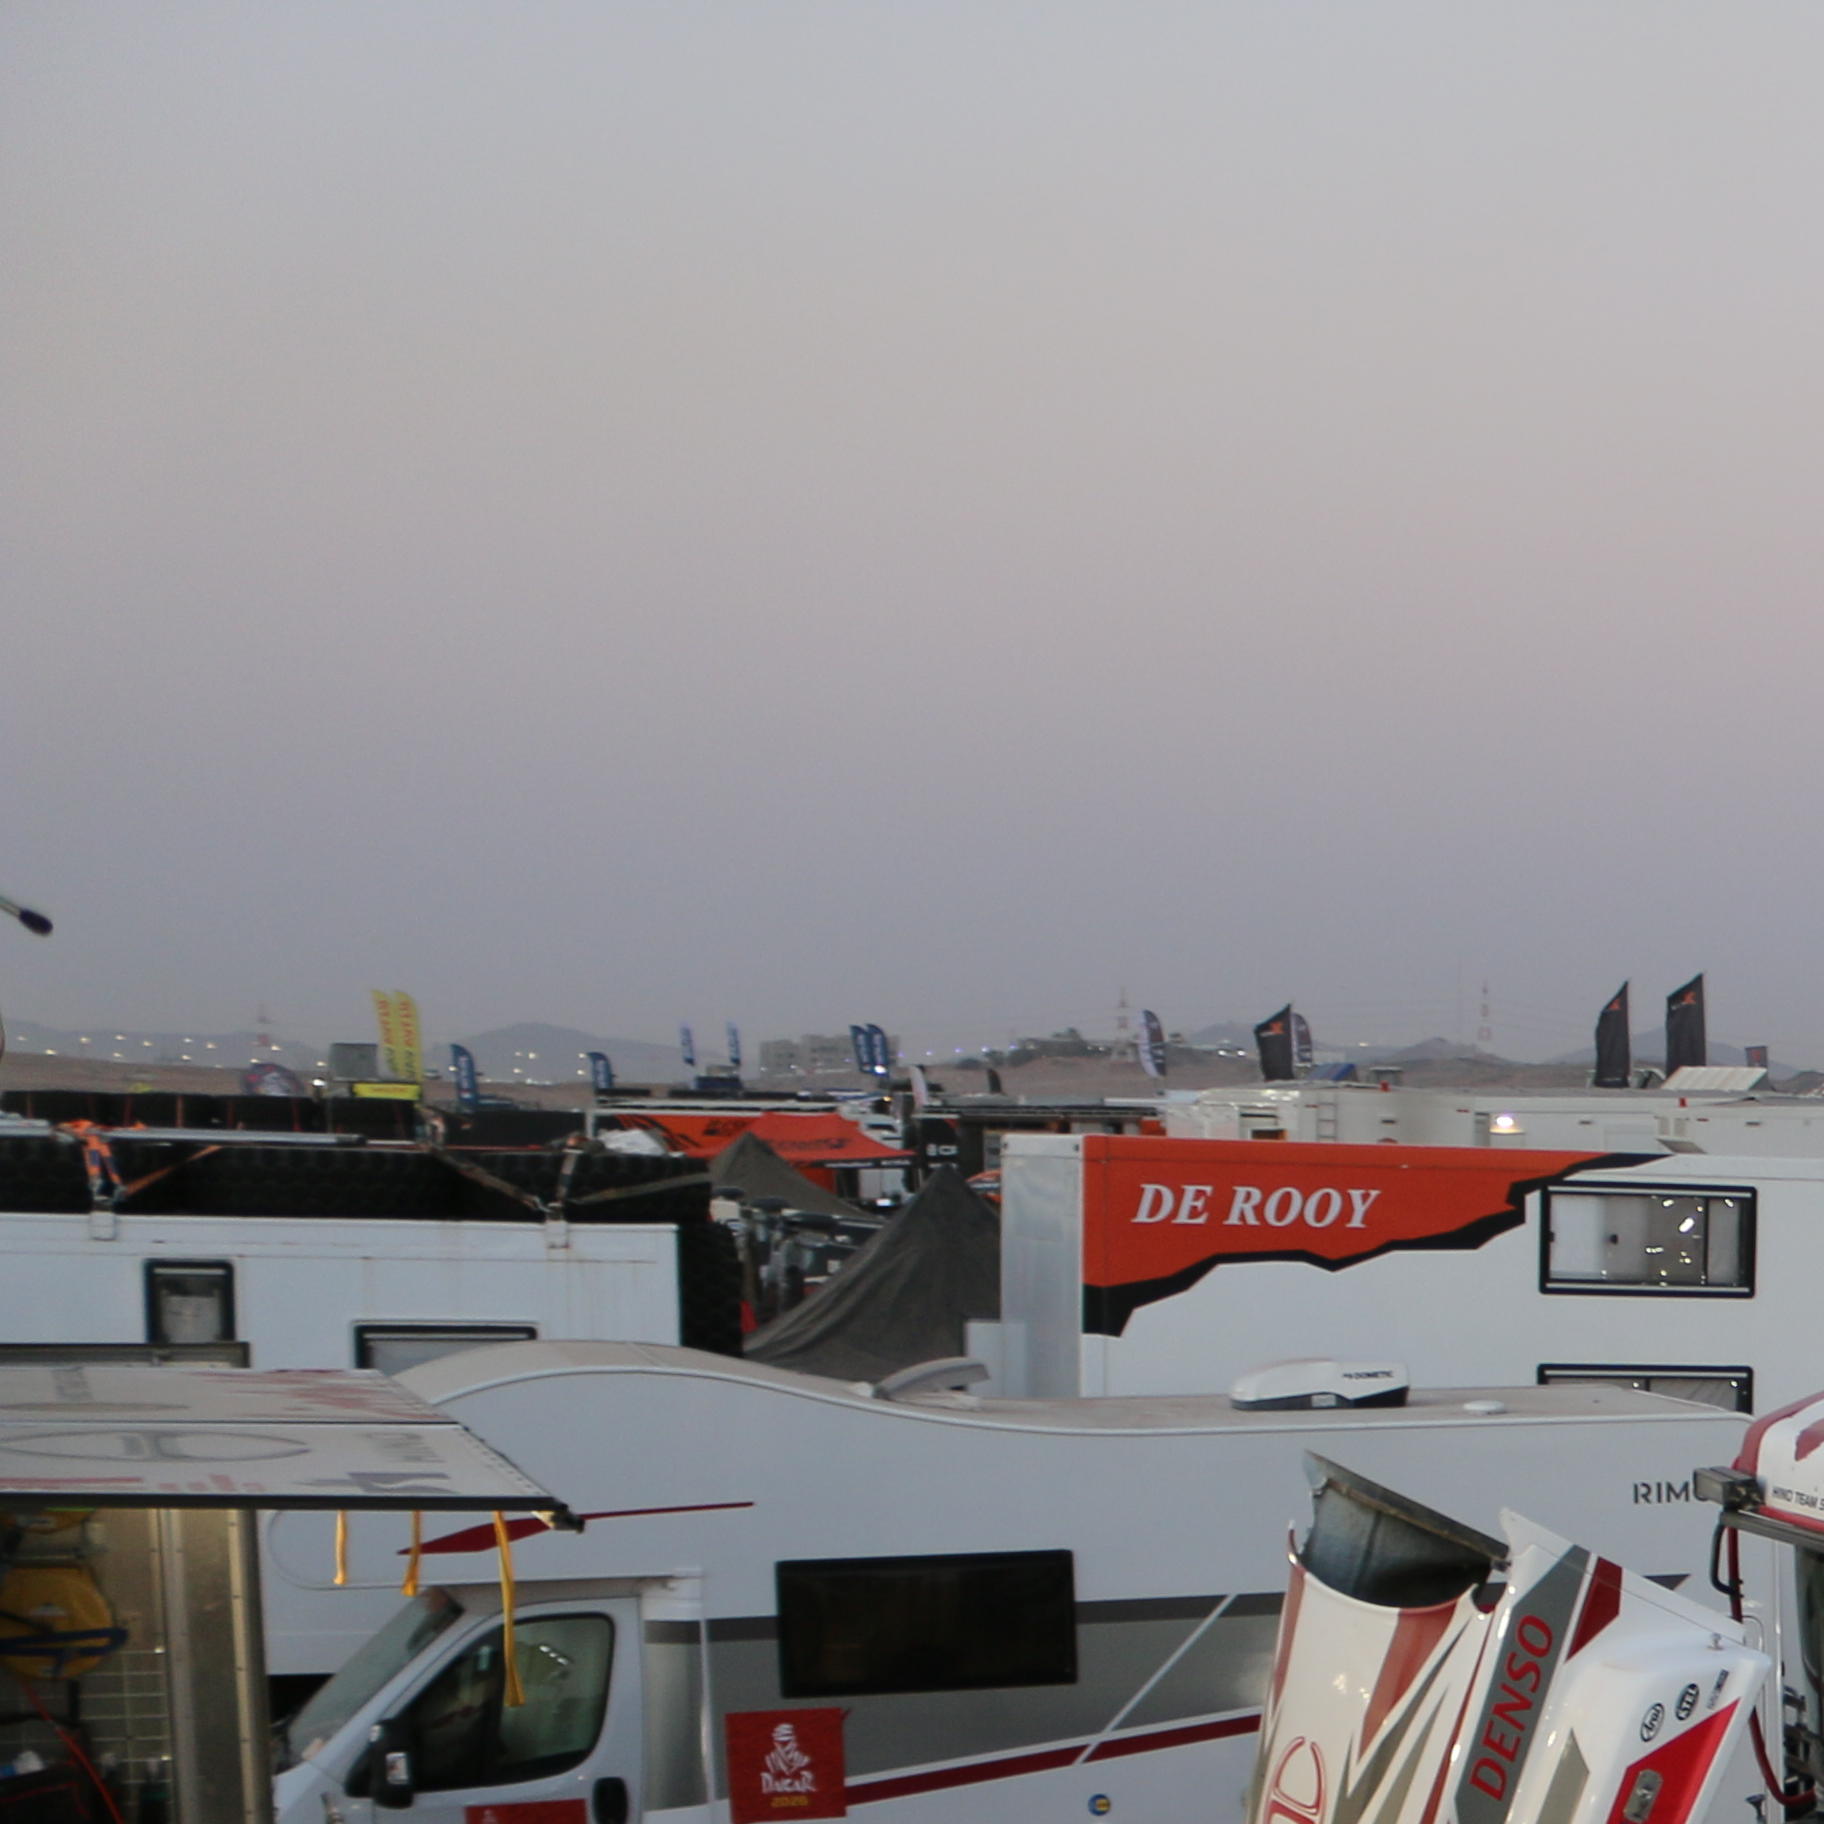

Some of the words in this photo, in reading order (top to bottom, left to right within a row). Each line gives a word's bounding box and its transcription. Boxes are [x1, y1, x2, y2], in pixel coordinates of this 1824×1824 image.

[1132, 1183, 1211, 1225] DE
[1223, 1186, 1380, 1228] ROOY
[1772, 1486, 1793, 1504] HINO
[1794, 1491, 1818, 1509] TEAM
[1467, 1614, 1553, 1802] DENSO
[1643, 1703, 1663, 1741] Arai
[760, 1771, 818, 1794] DAKAR
